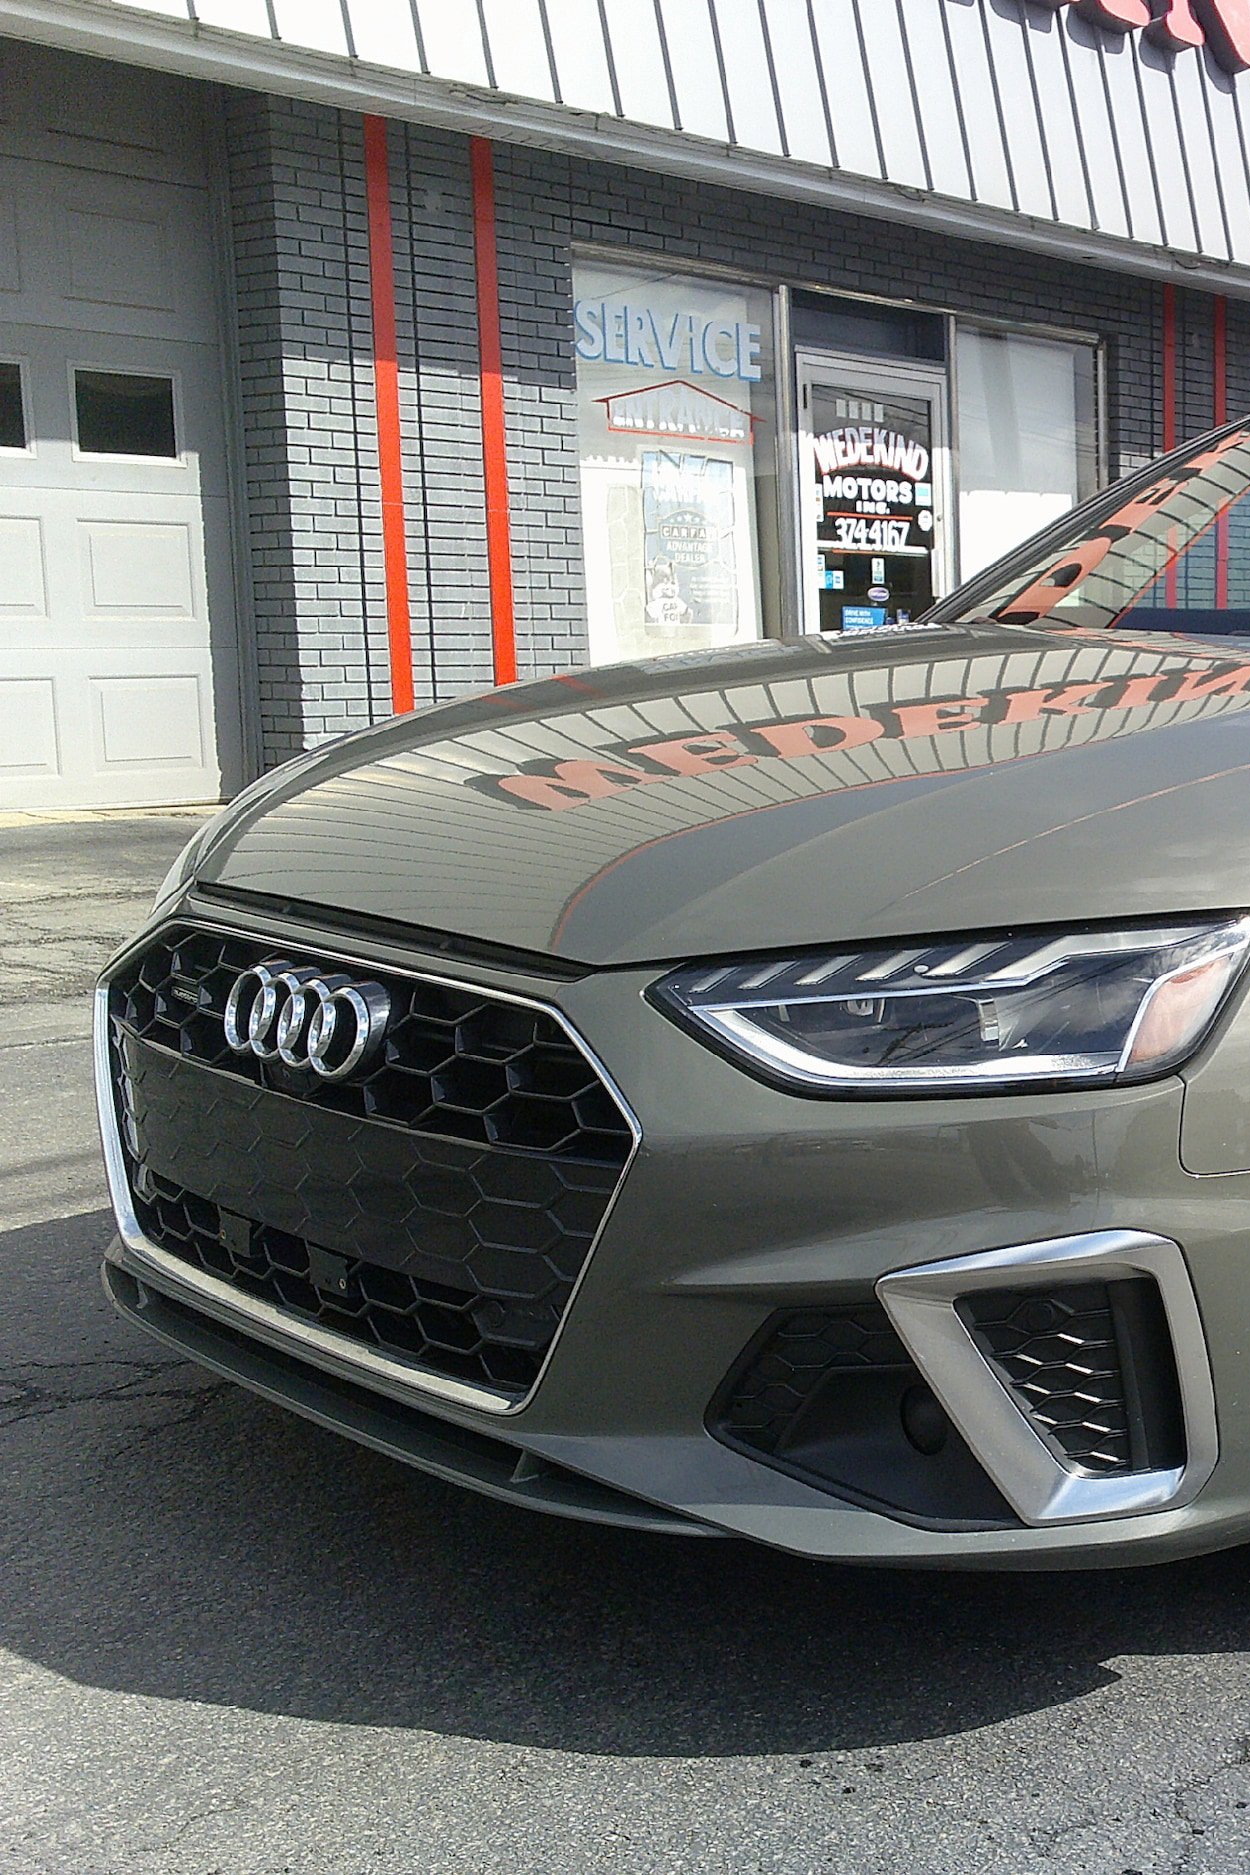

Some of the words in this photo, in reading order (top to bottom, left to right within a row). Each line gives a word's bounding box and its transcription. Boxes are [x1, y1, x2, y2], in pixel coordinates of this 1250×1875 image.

[573, 300, 762, 382] SERVICE
[813, 426, 929, 481] WEDEKIND
[823, 475, 913, 504] MOTORS
[855, 500, 891, 514] INC.
[661, 525, 716, 539] CARFA
[835, 517, 910, 552] 374-4167
